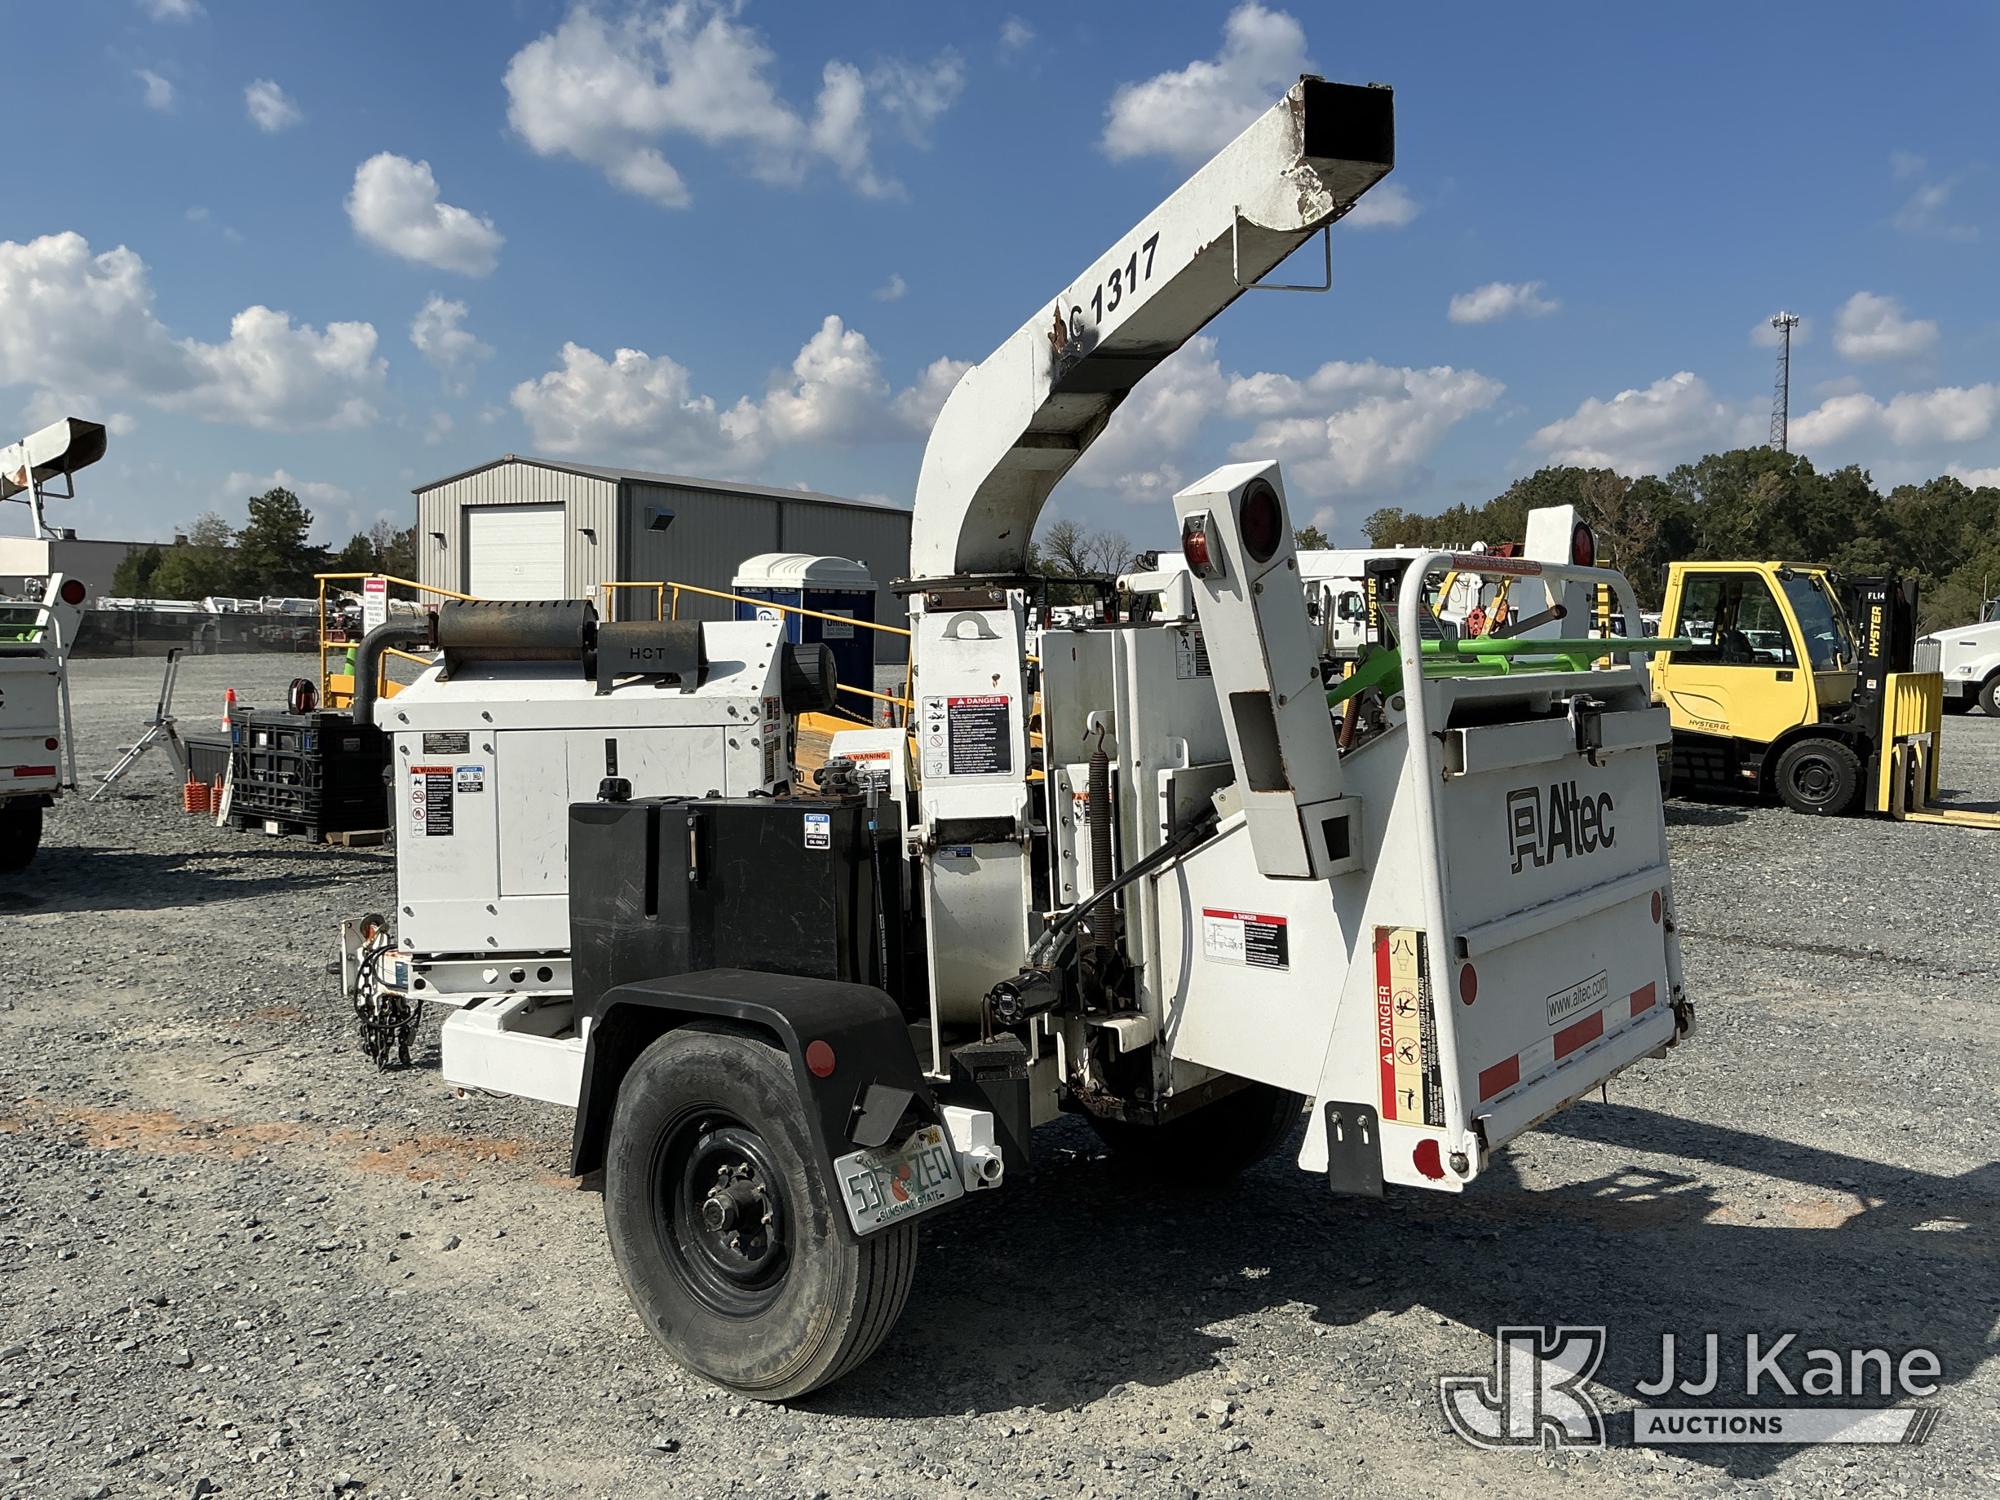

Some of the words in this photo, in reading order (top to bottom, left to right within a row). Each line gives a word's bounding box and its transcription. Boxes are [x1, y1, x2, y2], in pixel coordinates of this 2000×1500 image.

[1091, 231, 1160, 326] 1317
[1368, 577, 1377, 626] HYSTER
[1867, 592, 1886, 600] FL14
[1868, 605, 1882, 657] HYSTER
[630, 647, 666, 660] HOT
[966, 697, 1001, 705] DANGER
[1689, 719, 1719, 729] HYSTER
[853, 752, 886, 760] WARNING
[1547, 780, 1616, 865] Altec
[1418, 977, 1426, 1009] HAZARD
[1548, 976, 1608, 1017] www.altec.com
[1378, 985, 1393, 1048] DANGER
[1419, 1011, 1428, 1039] CRUSH
[1420, 1047, 1428, 1074] SEVER
[906, 1146, 953, 1192] ZEQ
[878, 1199, 914, 1222] SUNSHINE
[916, 1190, 941, 1206] STATE
